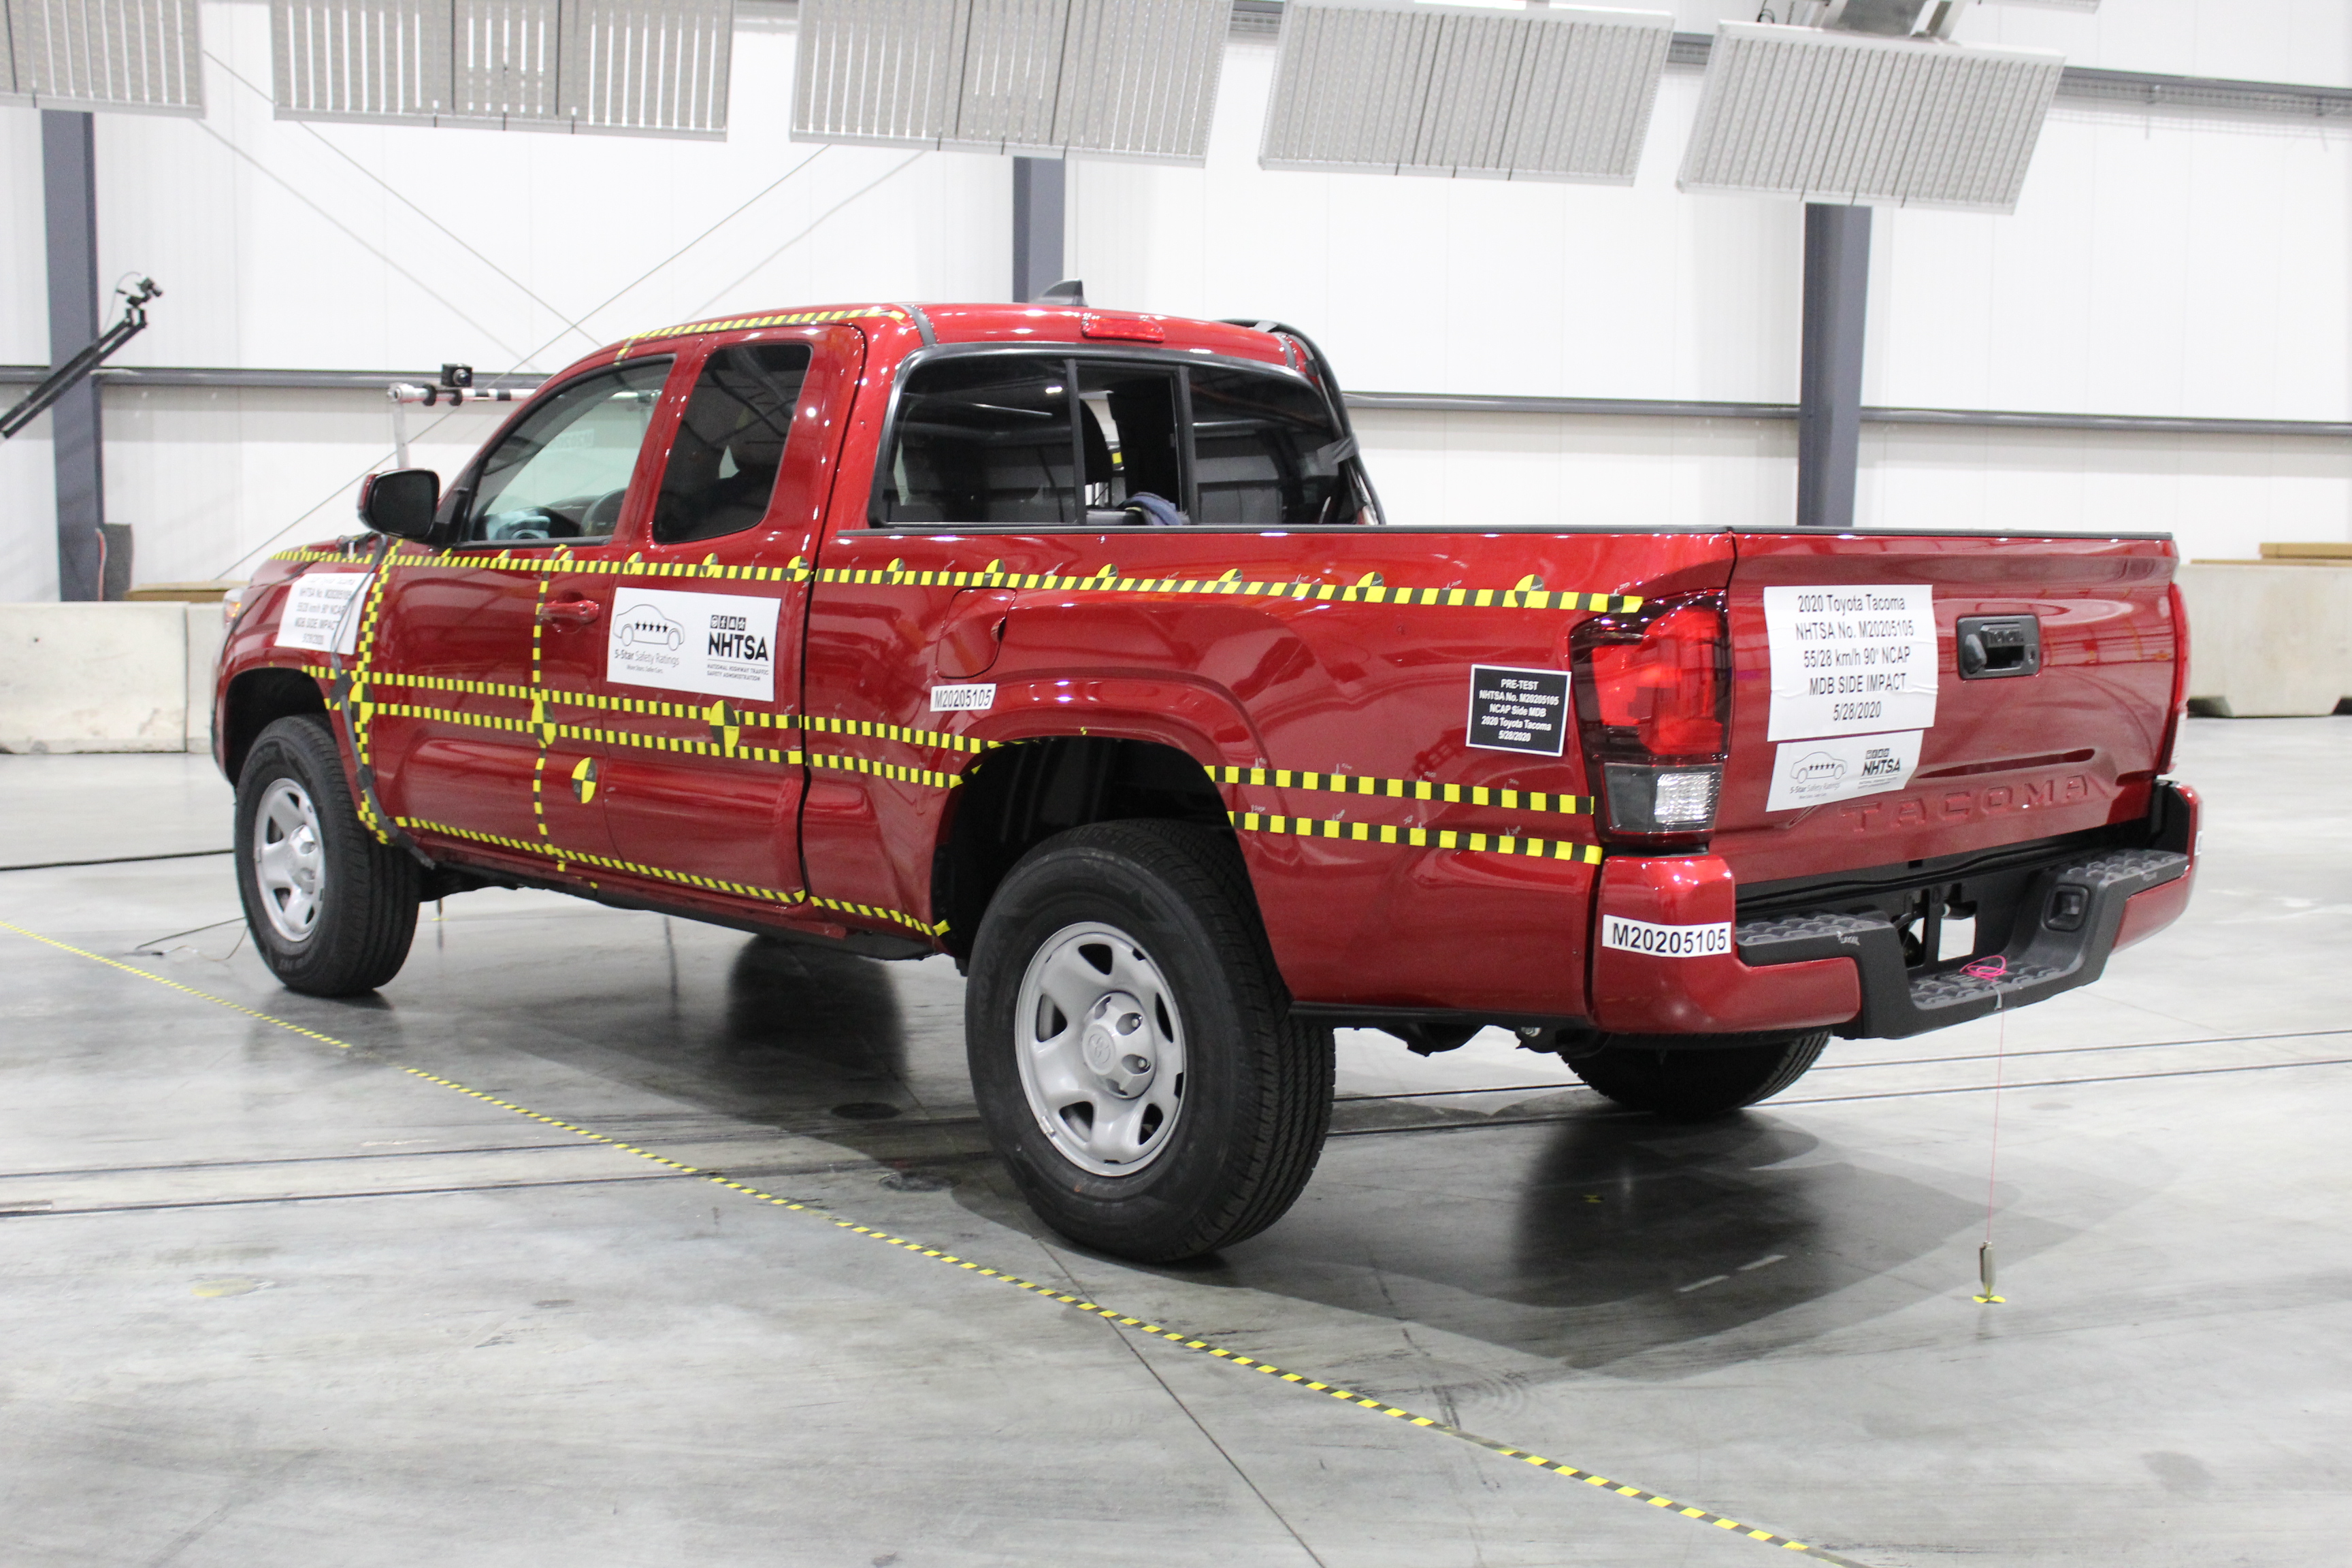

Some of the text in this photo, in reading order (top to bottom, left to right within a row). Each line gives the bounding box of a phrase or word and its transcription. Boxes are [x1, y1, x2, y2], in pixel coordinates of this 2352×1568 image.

[1798, 593, 1906, 616] 2020 Toyota Tacoma
[1795, 620, 1914, 640] NHTSA No. M20205105
[708, 632, 769, 662] NHTSA
[1804, 649, 1833, 668] 55/28
[1835, 648, 1861, 666] km/h
[1882, 646, 1911, 664] NCAP
[615, 649, 679, 668] 5-Star Safety Ratings
[1501, 679, 1539, 691] PRE-TEST
[1809, 672, 1906, 696] MDB SIDE IMPACT
[934, 689, 992, 708] M20205105
[1479, 689, 1559, 706] NHTSA No. M20205105
[1489, 703, 1547, 717] NCAP Side MDB
[1833, 701, 1882, 721] 5/28/2020
[1481, 715, 1552, 731] 2020 Toyota Tacoma
[1498, 730, 1531, 742] 5/28/2020
[1861, 757, 1901, 777] NHTSA
[1840, 774, 2089, 833] TACOMA
[1612, 922, 1727, 953] M20205105
